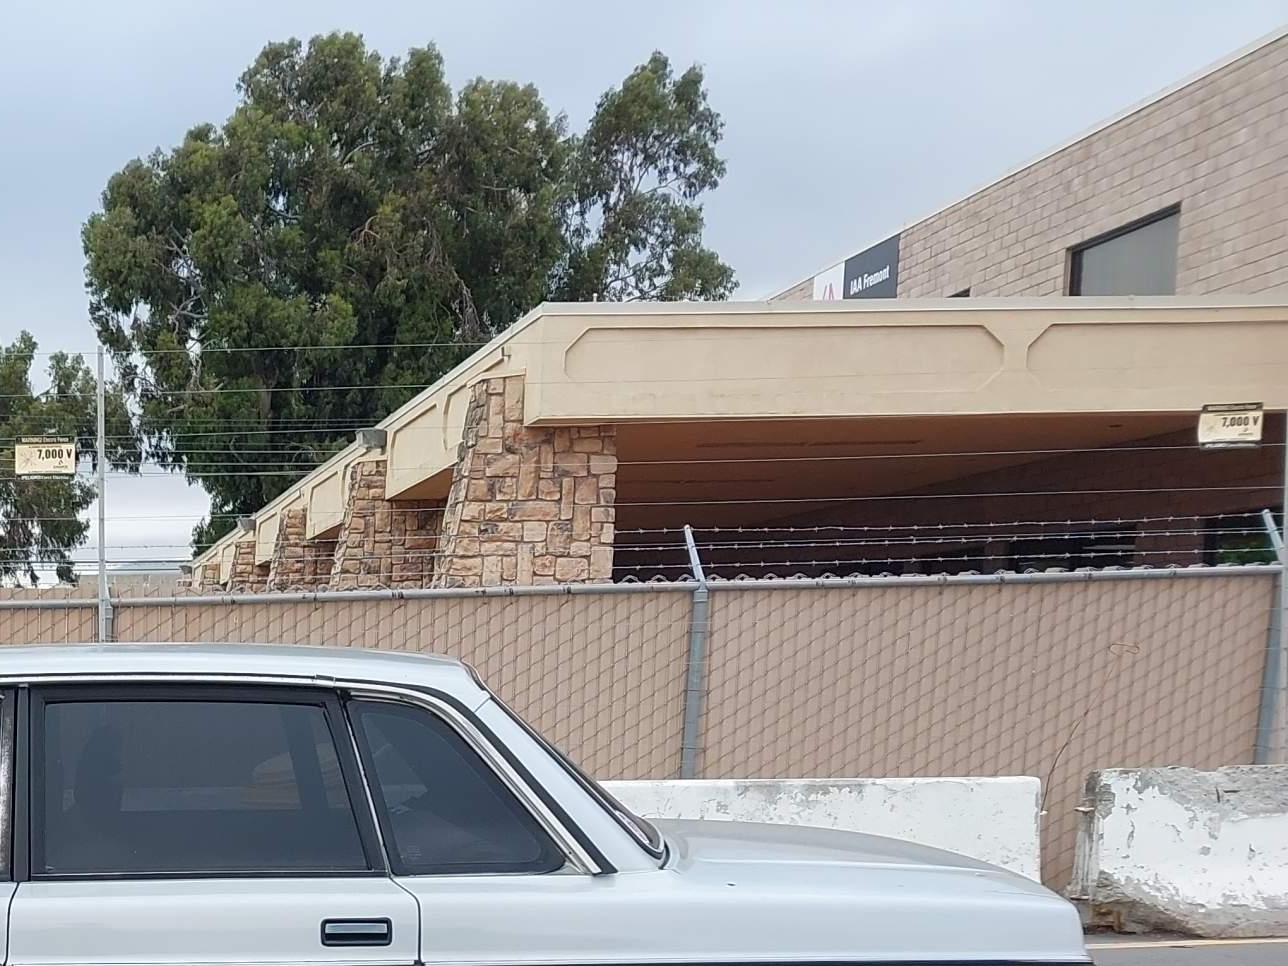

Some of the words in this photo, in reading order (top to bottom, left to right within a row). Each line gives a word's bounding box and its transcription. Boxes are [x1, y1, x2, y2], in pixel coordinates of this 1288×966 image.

[850, 278, 862, 296] IAA
[863, 264, 890, 289] Fremont
[1221, 416, 1249, 429] 7,000
[1253, 415, 1261, 426] V
[37, 448, 64, 461] 7,000
[66, 448, 73, 459] V
